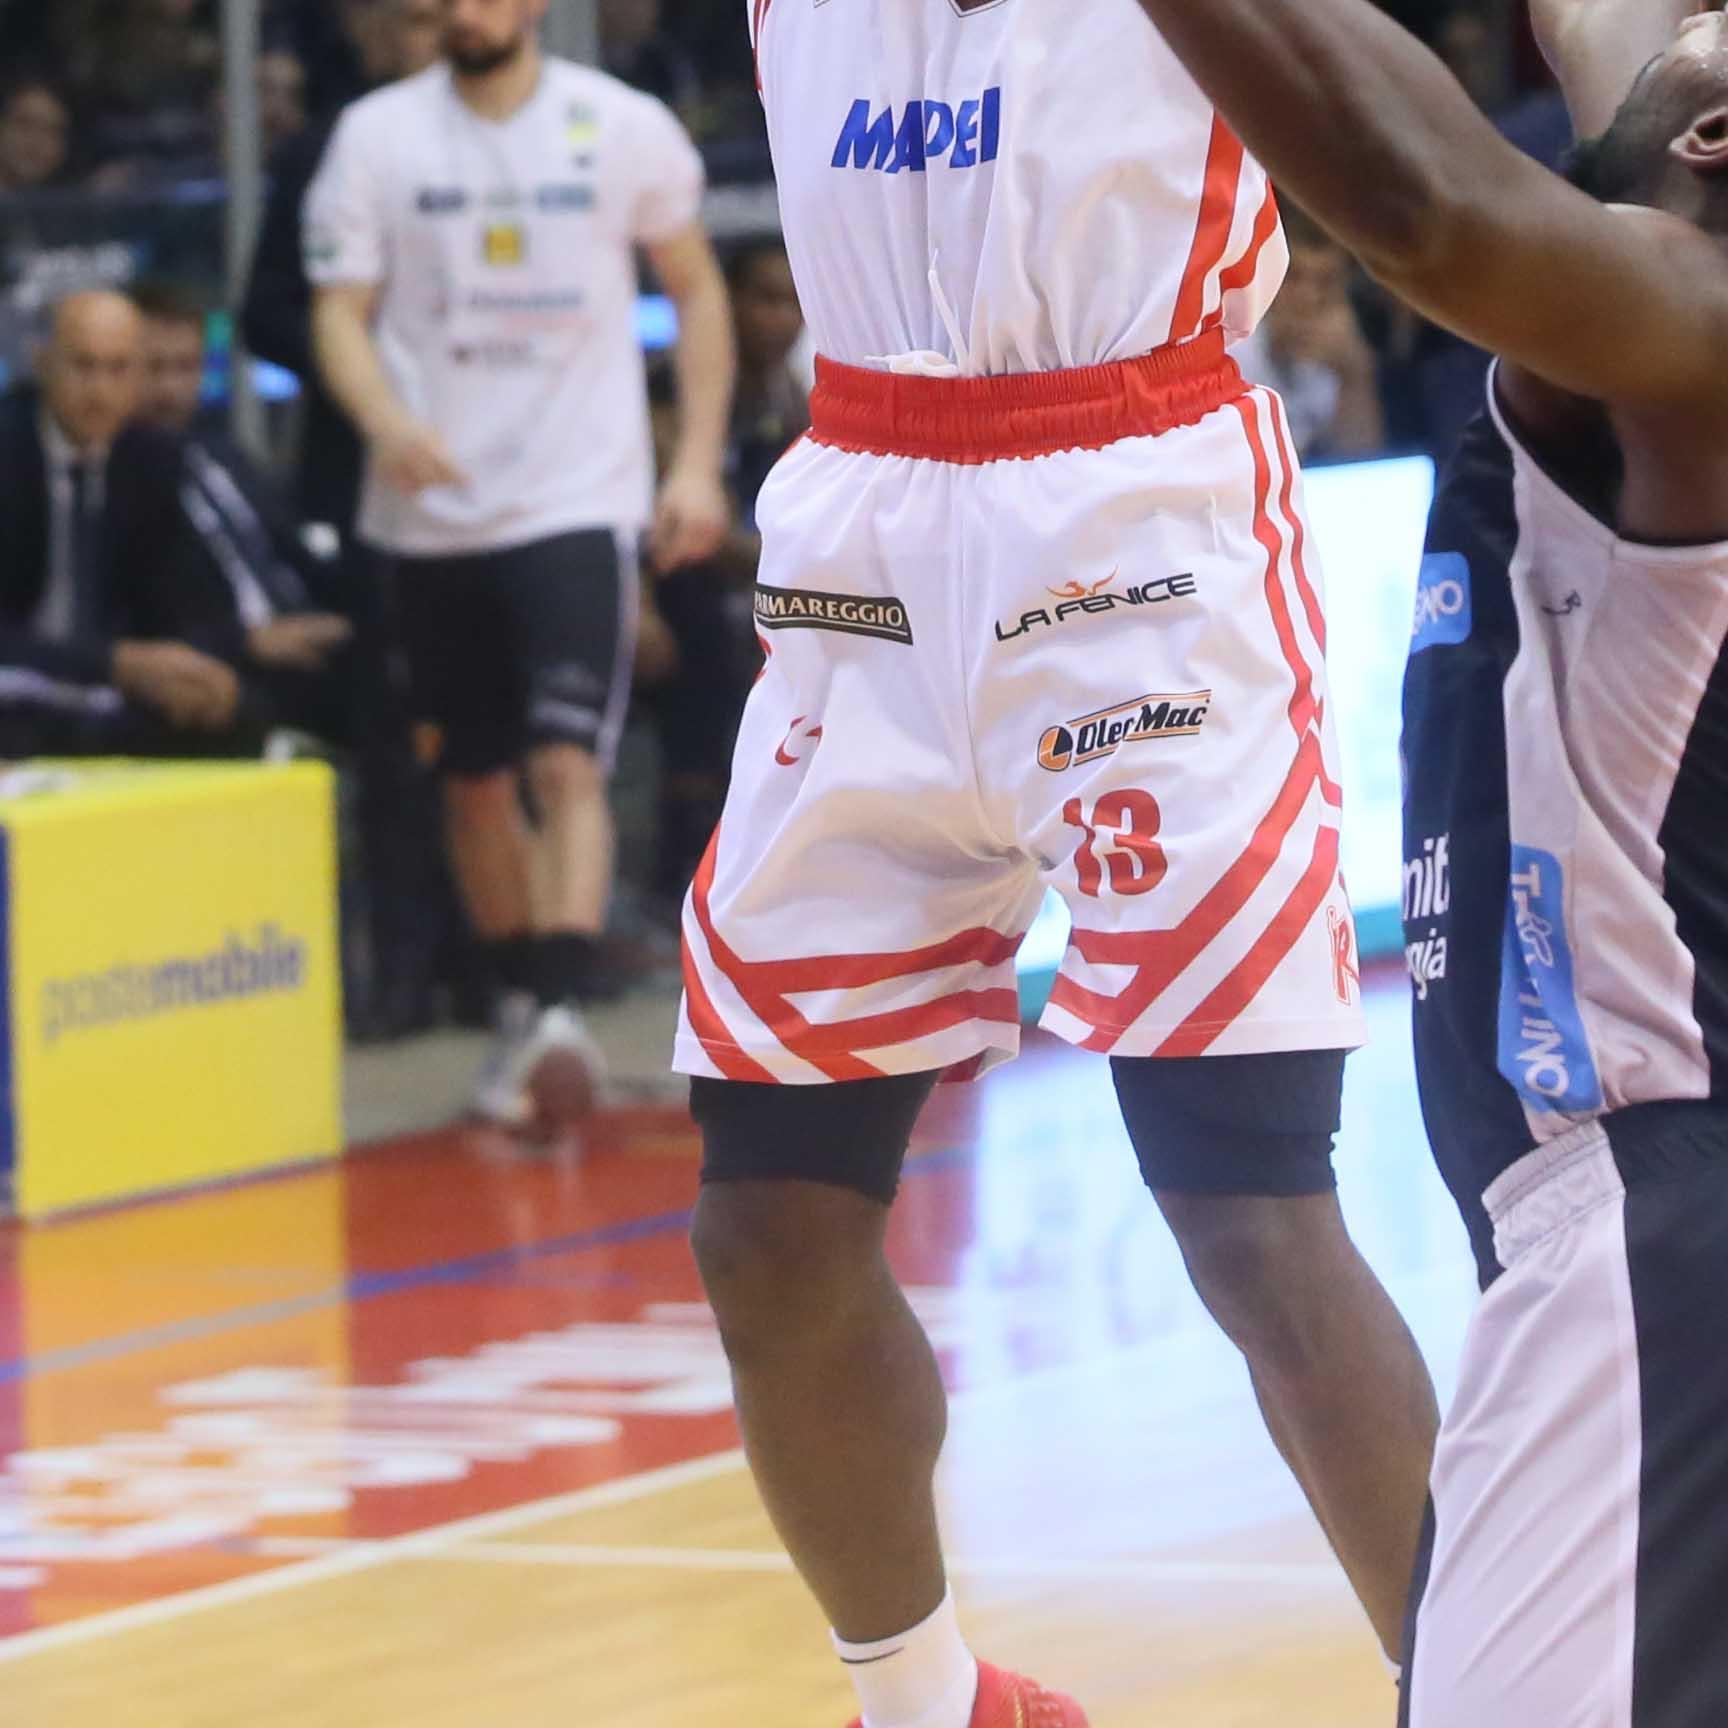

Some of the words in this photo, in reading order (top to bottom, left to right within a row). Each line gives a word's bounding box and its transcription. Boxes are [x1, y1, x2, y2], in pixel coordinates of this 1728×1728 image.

[831, 86, 1000, 174] MAPEI
[995, 609, 1052, 641] LA
[1055, 573, 1197, 622] FENICE
[1062, 788, 1168, 898] 13
